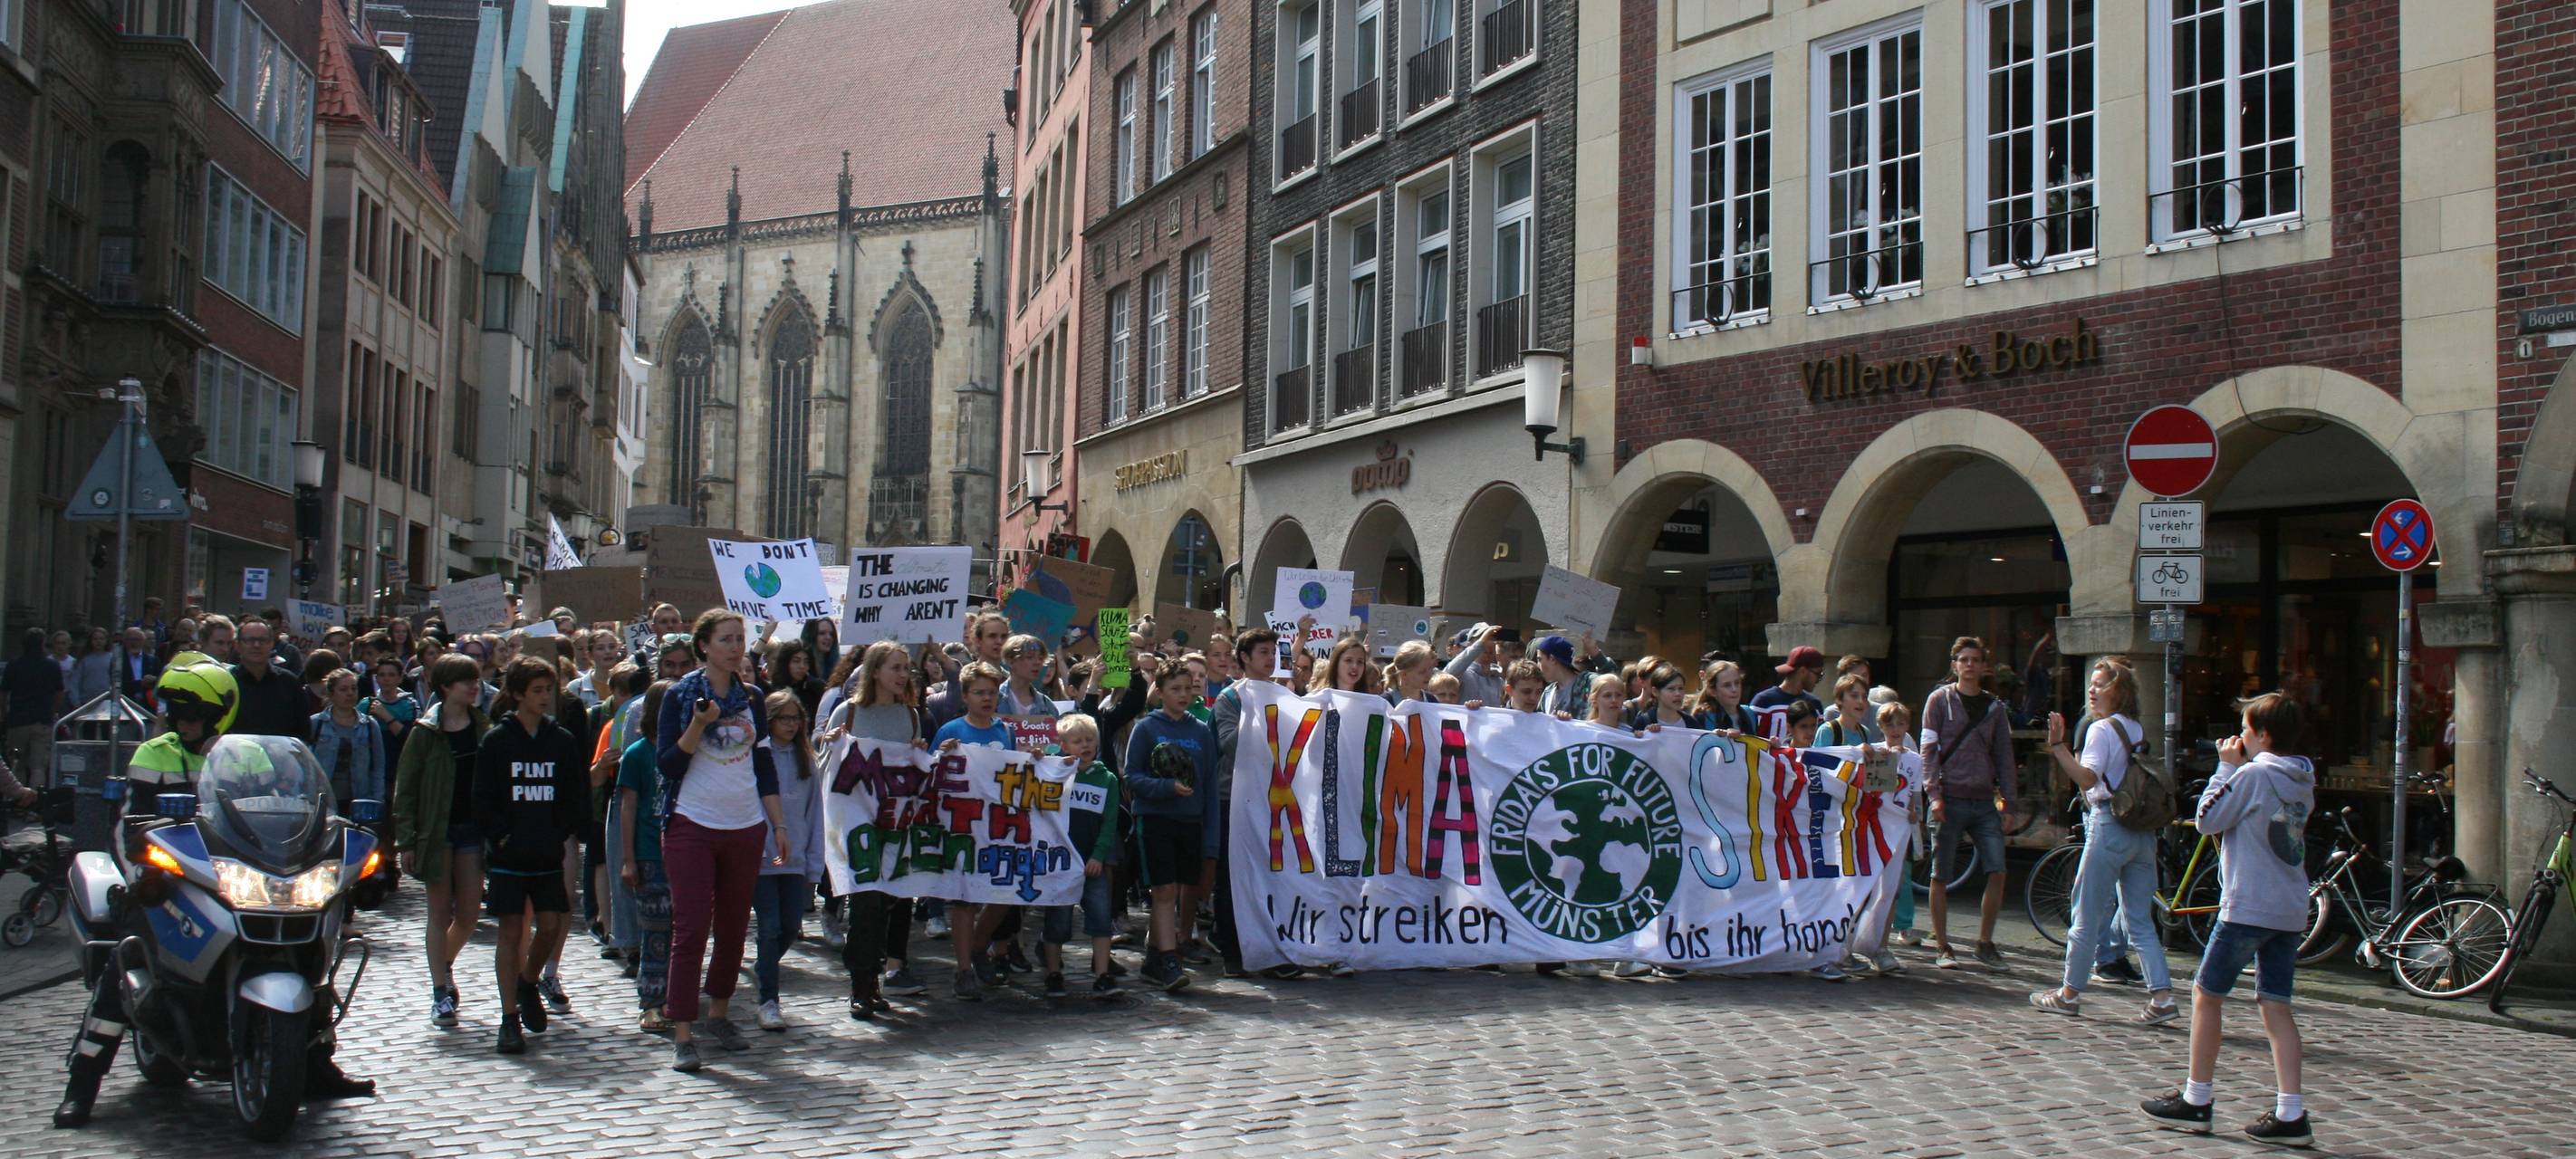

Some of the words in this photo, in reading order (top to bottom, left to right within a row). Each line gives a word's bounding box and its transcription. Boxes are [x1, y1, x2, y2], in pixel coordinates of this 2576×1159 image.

[2528, 311, 2576, 327] Bogen
[1801, 351, 1944, 401] Villeroy
[1953, 342, 1980, 380] &
[1991, 317, 2098, 377] Boch
[1350, 456, 1411, 495] pomp
[2150, 507, 2192, 518] Linien-
[2148, 521, 2195, 532] verkehr
[2161, 533, 2181, 544] frei
[713, 541, 735, 558] WE
[857, 554, 894, 577] THE
[858, 584, 873, 599] IS
[878, 578, 949, 598] CHANGING
[2160, 587, 2181, 598] frei
[299, 601, 334, 619] make
[728, 599, 769, 619] HAVE
[782, 599, 828, 618] TIME
[854, 605, 882, 623] WHY
[1101, 610, 1128, 624] KLIMA
[1028, 734, 1050, 747] fish
[511, 761, 555, 778] PLNT
[513, 785, 554, 801] PWR
[995, 760, 1066, 811] the
[1264, 704, 1482, 886] KLIMA
[1688, 733, 1893, 890] STREIK
[1491, 759, 1559, 856] FRIDAYS
[1565, 744, 1616, 778] FOR
[1620, 759, 1682, 859] FUTURE
[1509, 886, 1666, 943] MÜNSTER
[1266, 894, 1325, 944] Wir
[1340, 896, 1508, 944] streiken
[1665, 915, 1710, 960] bis
[1727, 912, 1767, 958] ihr
